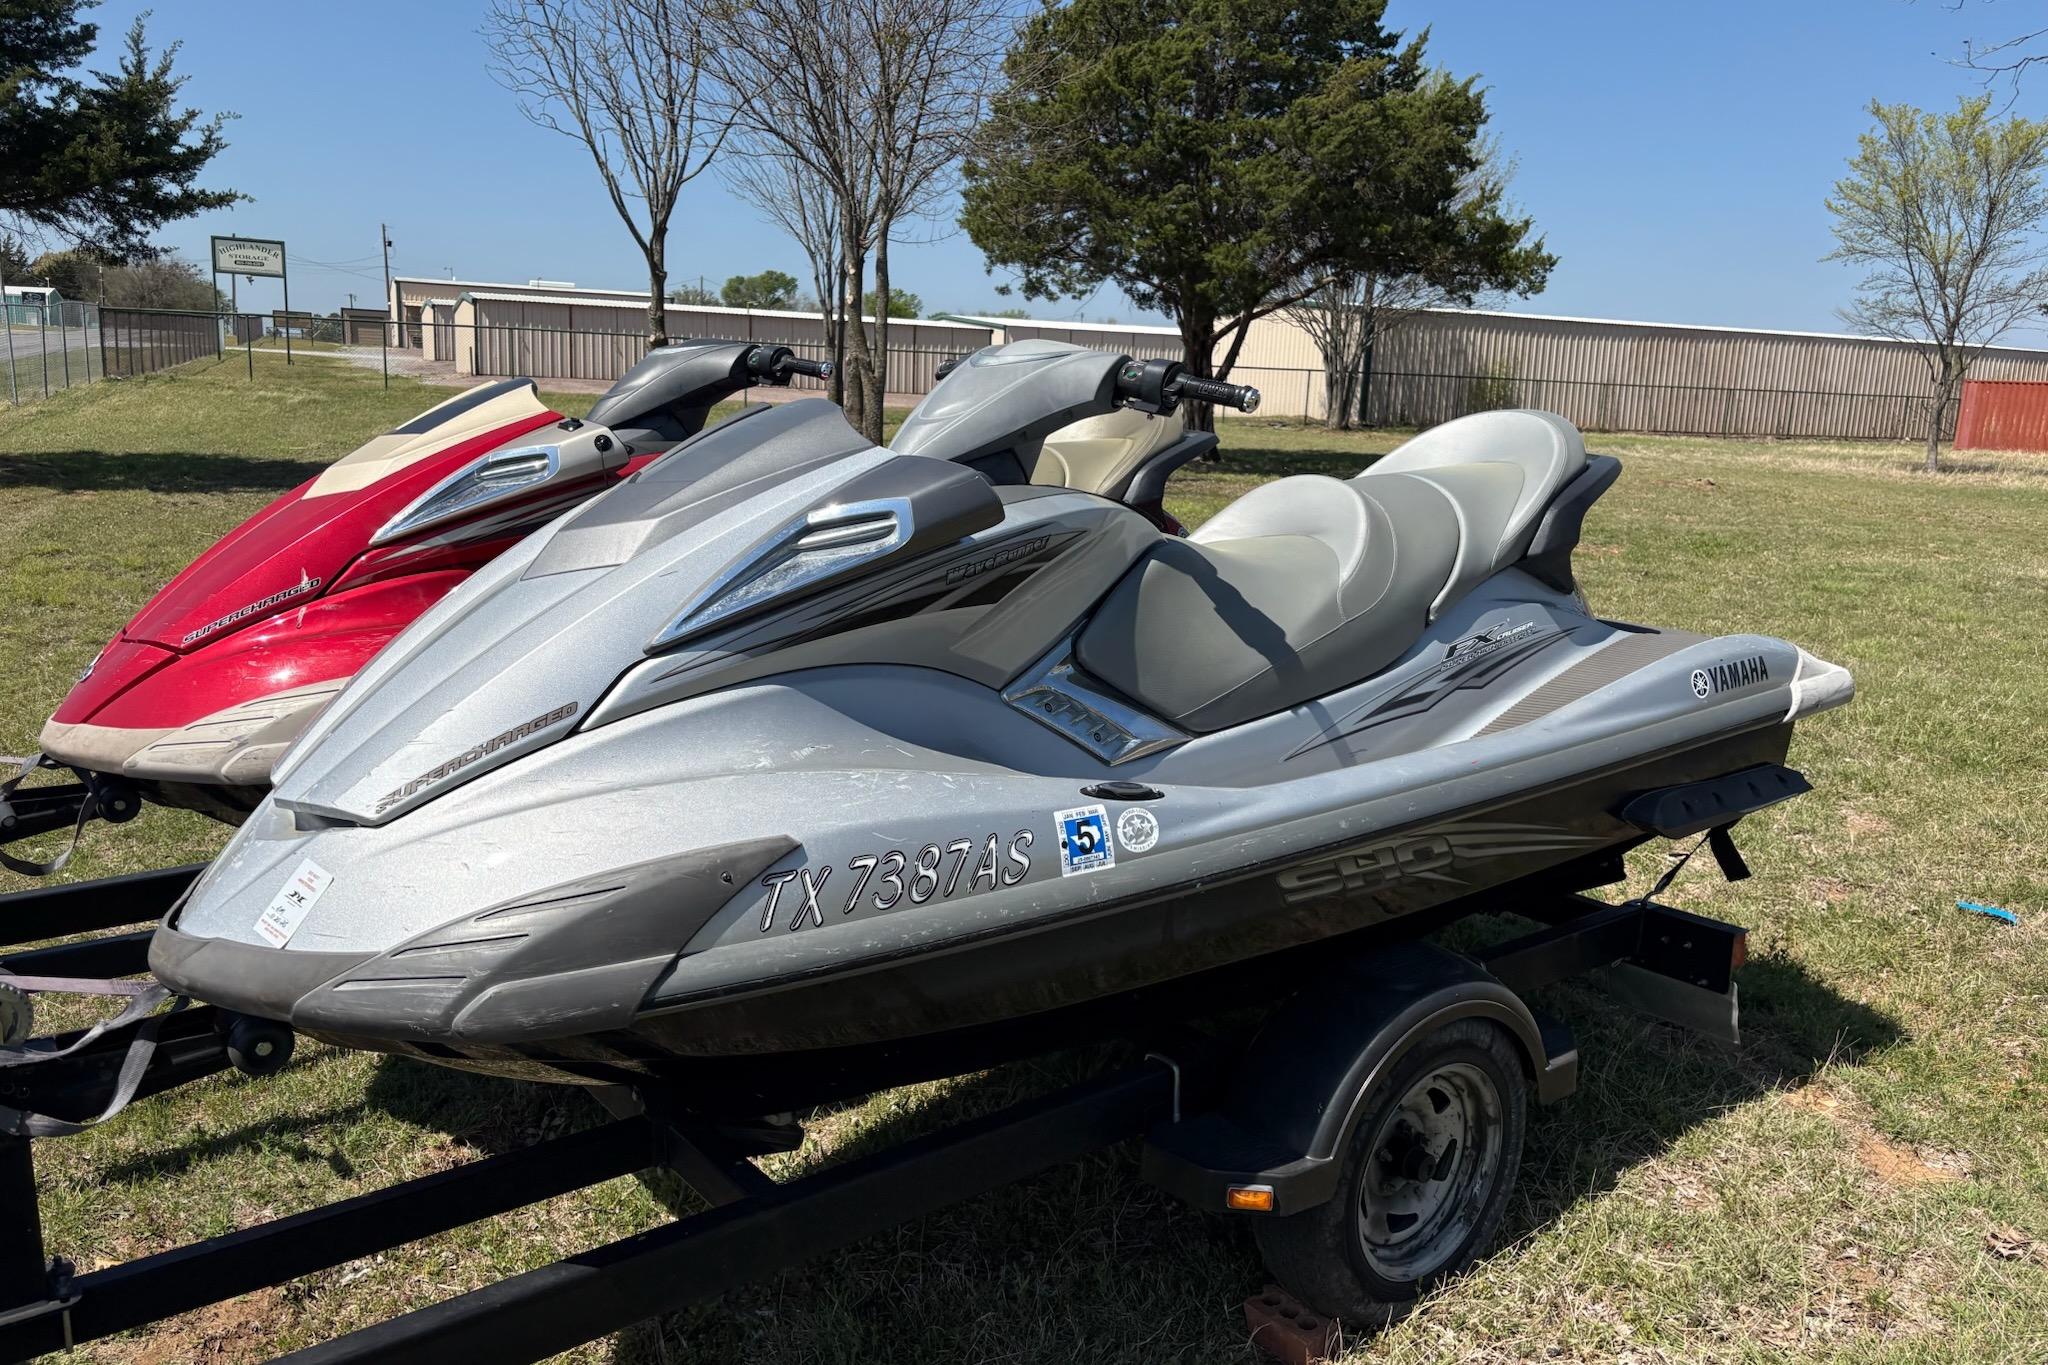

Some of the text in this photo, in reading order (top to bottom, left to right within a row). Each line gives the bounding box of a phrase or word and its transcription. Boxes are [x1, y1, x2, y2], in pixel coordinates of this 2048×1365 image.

[218, 243, 279, 260] HIGHLANDER
[228, 253, 270, 261] STORAGE
[945, 534, 1052, 585] WaveRunner
[182, 576, 321, 644] SUPERCHARGED
[1441, 621, 1534, 662] FX CRUISER
[1707, 655, 1769, 693] YAMAHA
[375, 701, 578, 815] SUPERCHARGED
[1076, 819, 1096, 855] 5
[760, 829, 1034, 932] TX 7387AS
